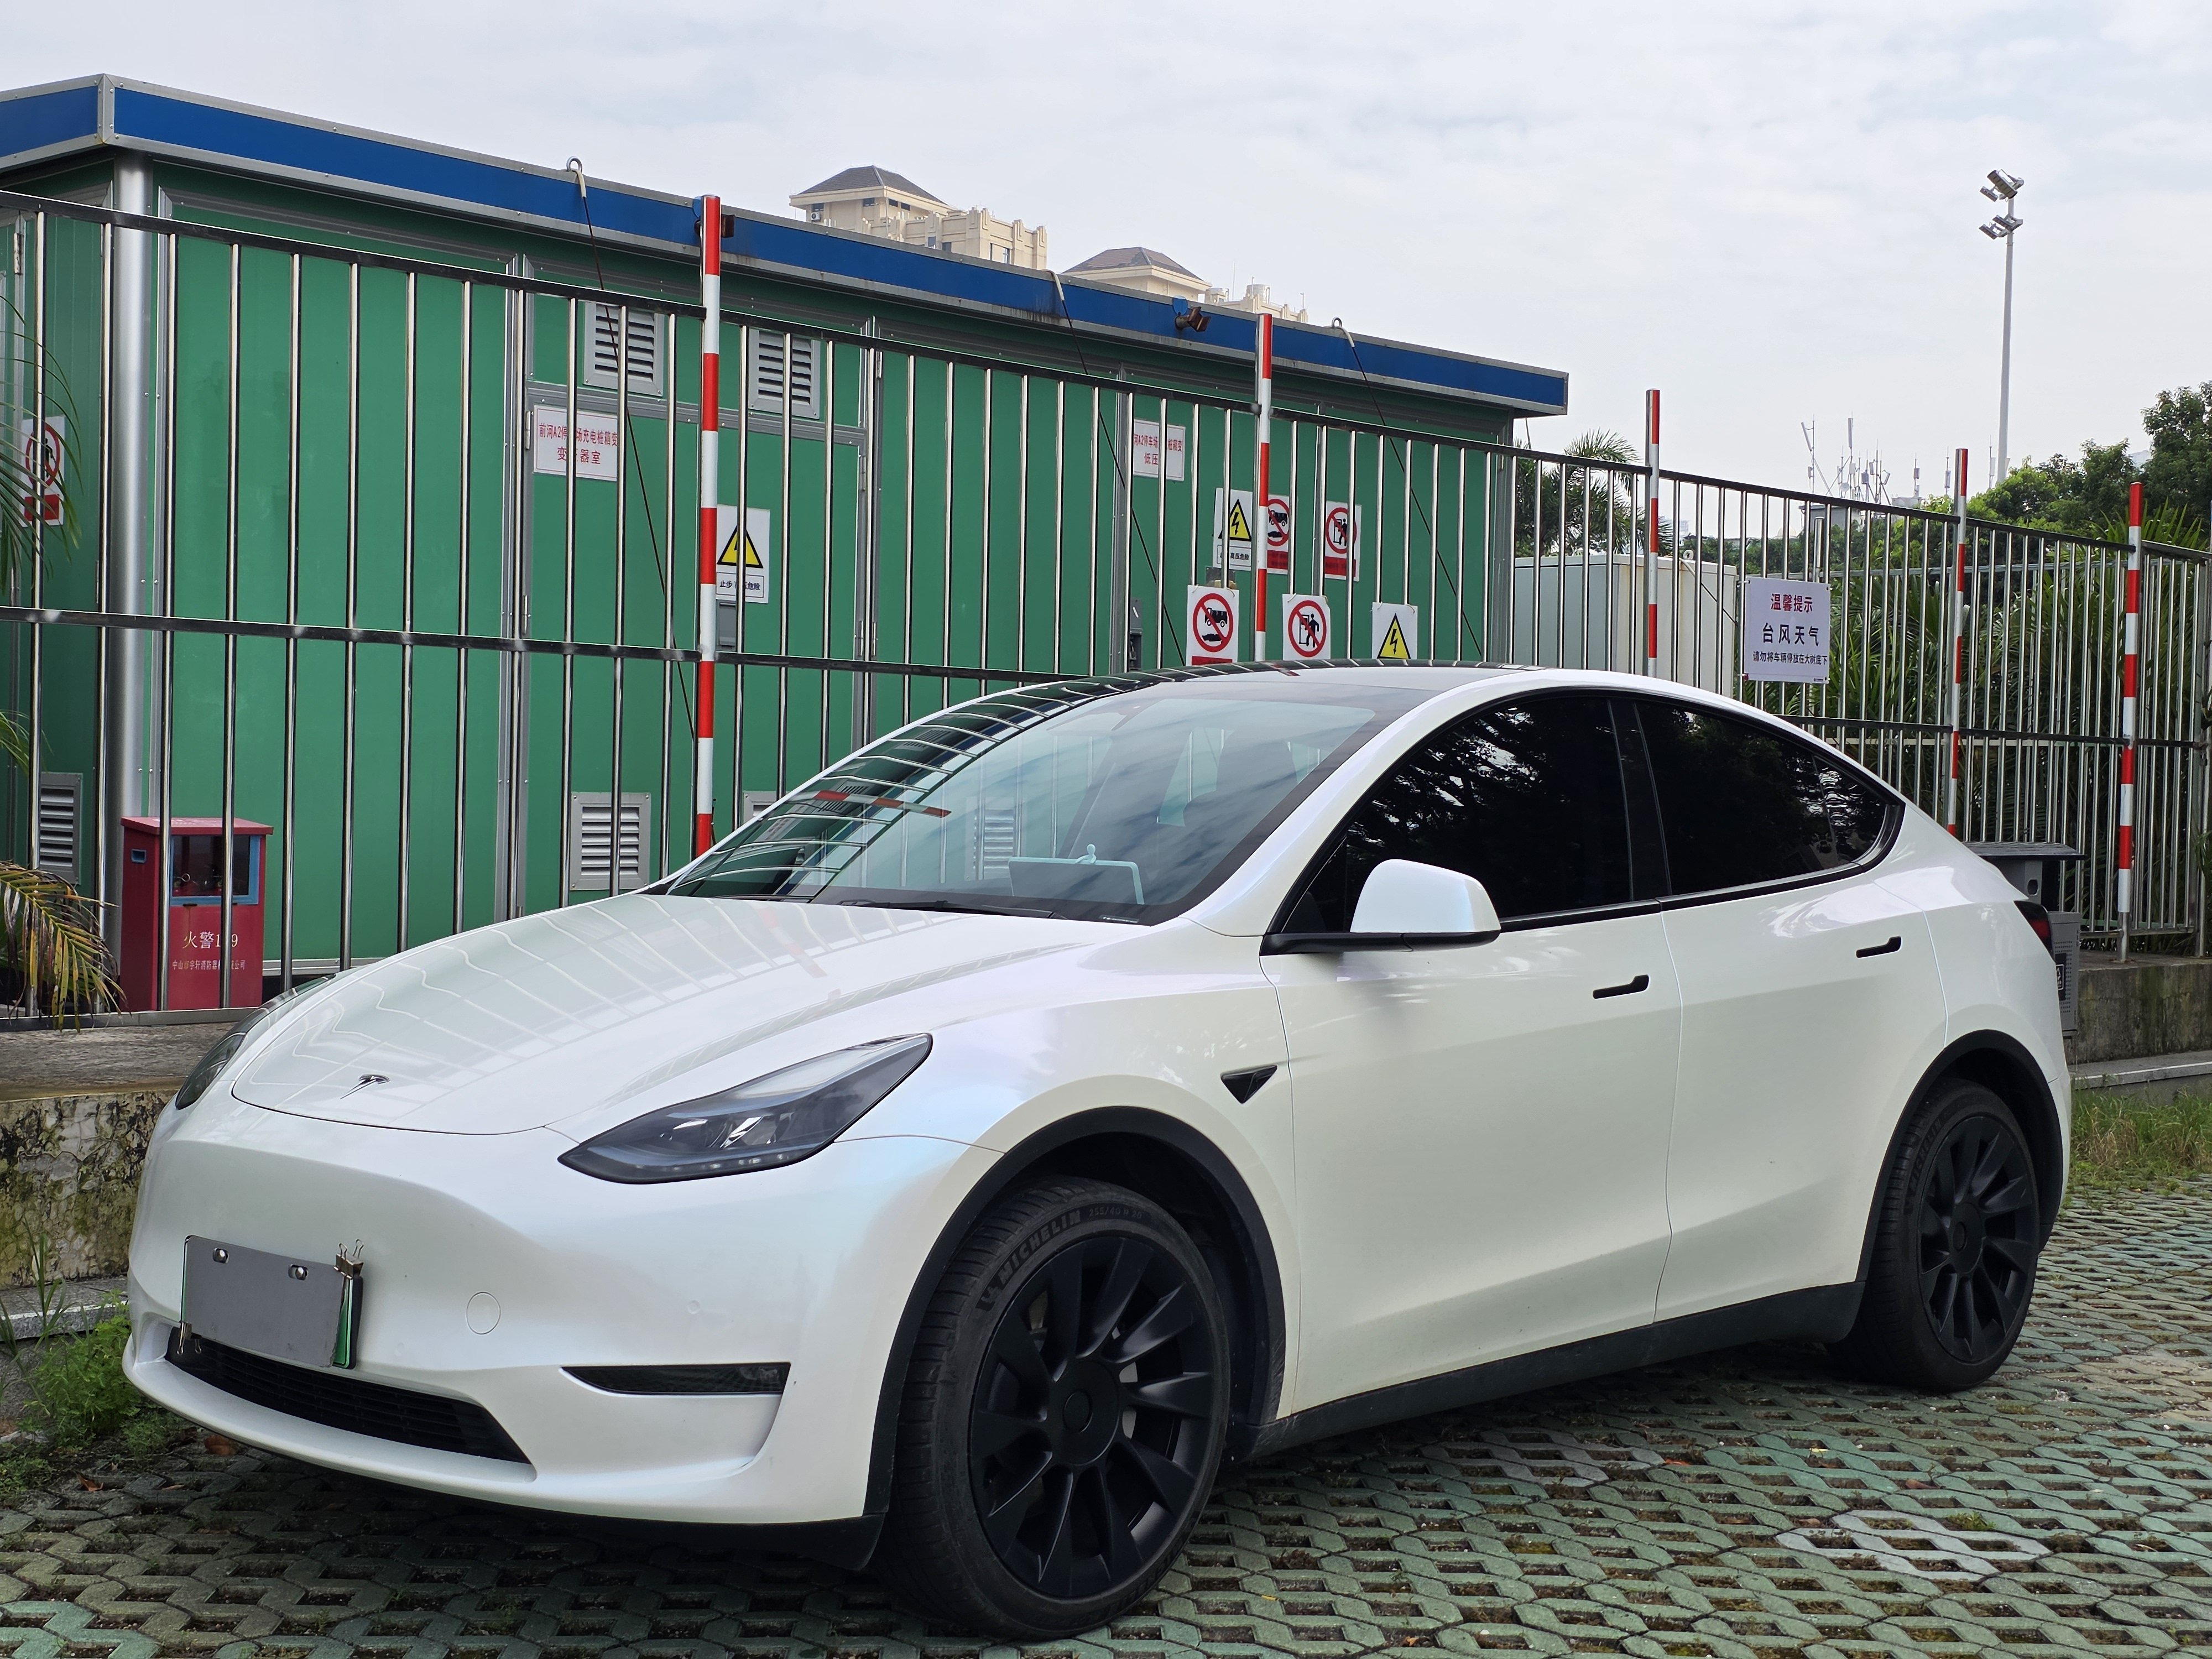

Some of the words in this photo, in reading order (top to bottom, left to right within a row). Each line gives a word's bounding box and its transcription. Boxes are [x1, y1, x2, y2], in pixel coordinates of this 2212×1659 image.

[539, 422, 618, 446] 前河A2停场充电桩箱变
[557, 446, 601, 465] 变器室
[719, 579, 760, 591] 止步危险
[1771, 593, 1813, 613] 温馨提示
[1762, 622, 1819, 646] 台风天气
[1752, 650, 1828, 665] 请勿将车辆停放在大树底下
[182, 931, 238, 949] 火警19
[1089, 1207, 1121, 1217] 255/40
[1132, 1210, 1142, 1219] 20
[999, 1209, 1081, 1285] MICHELIN
